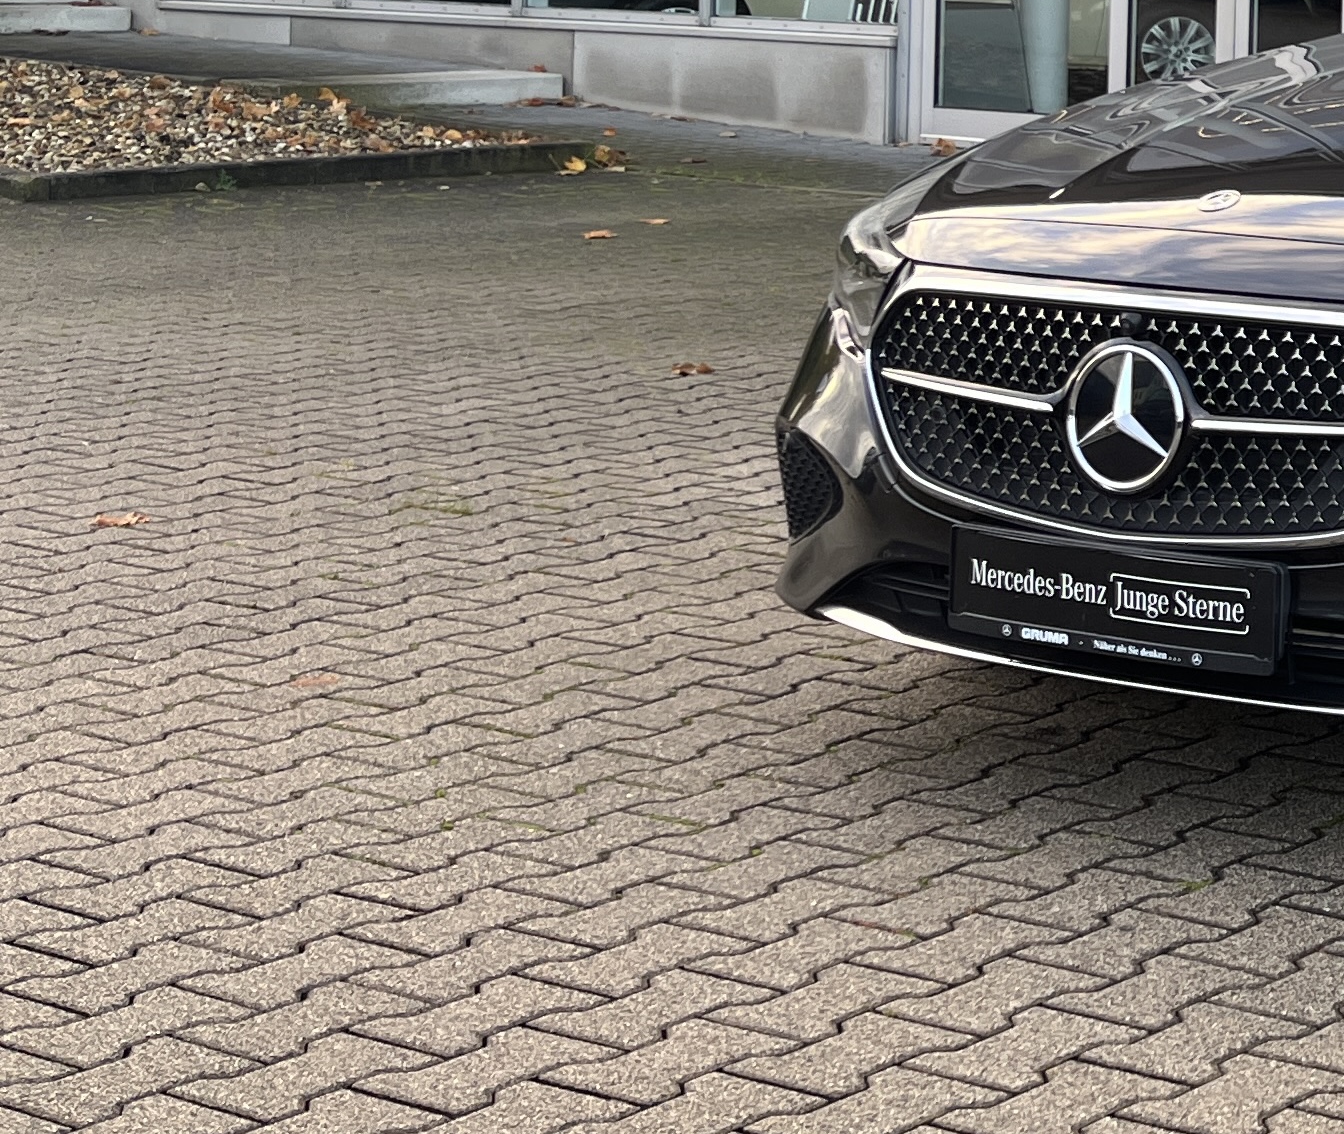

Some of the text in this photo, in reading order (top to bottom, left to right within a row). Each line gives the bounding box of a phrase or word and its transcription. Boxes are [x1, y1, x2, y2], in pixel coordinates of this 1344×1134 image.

[970, 558, 1245, 623] Mercedes-Benz Junge Sterne
